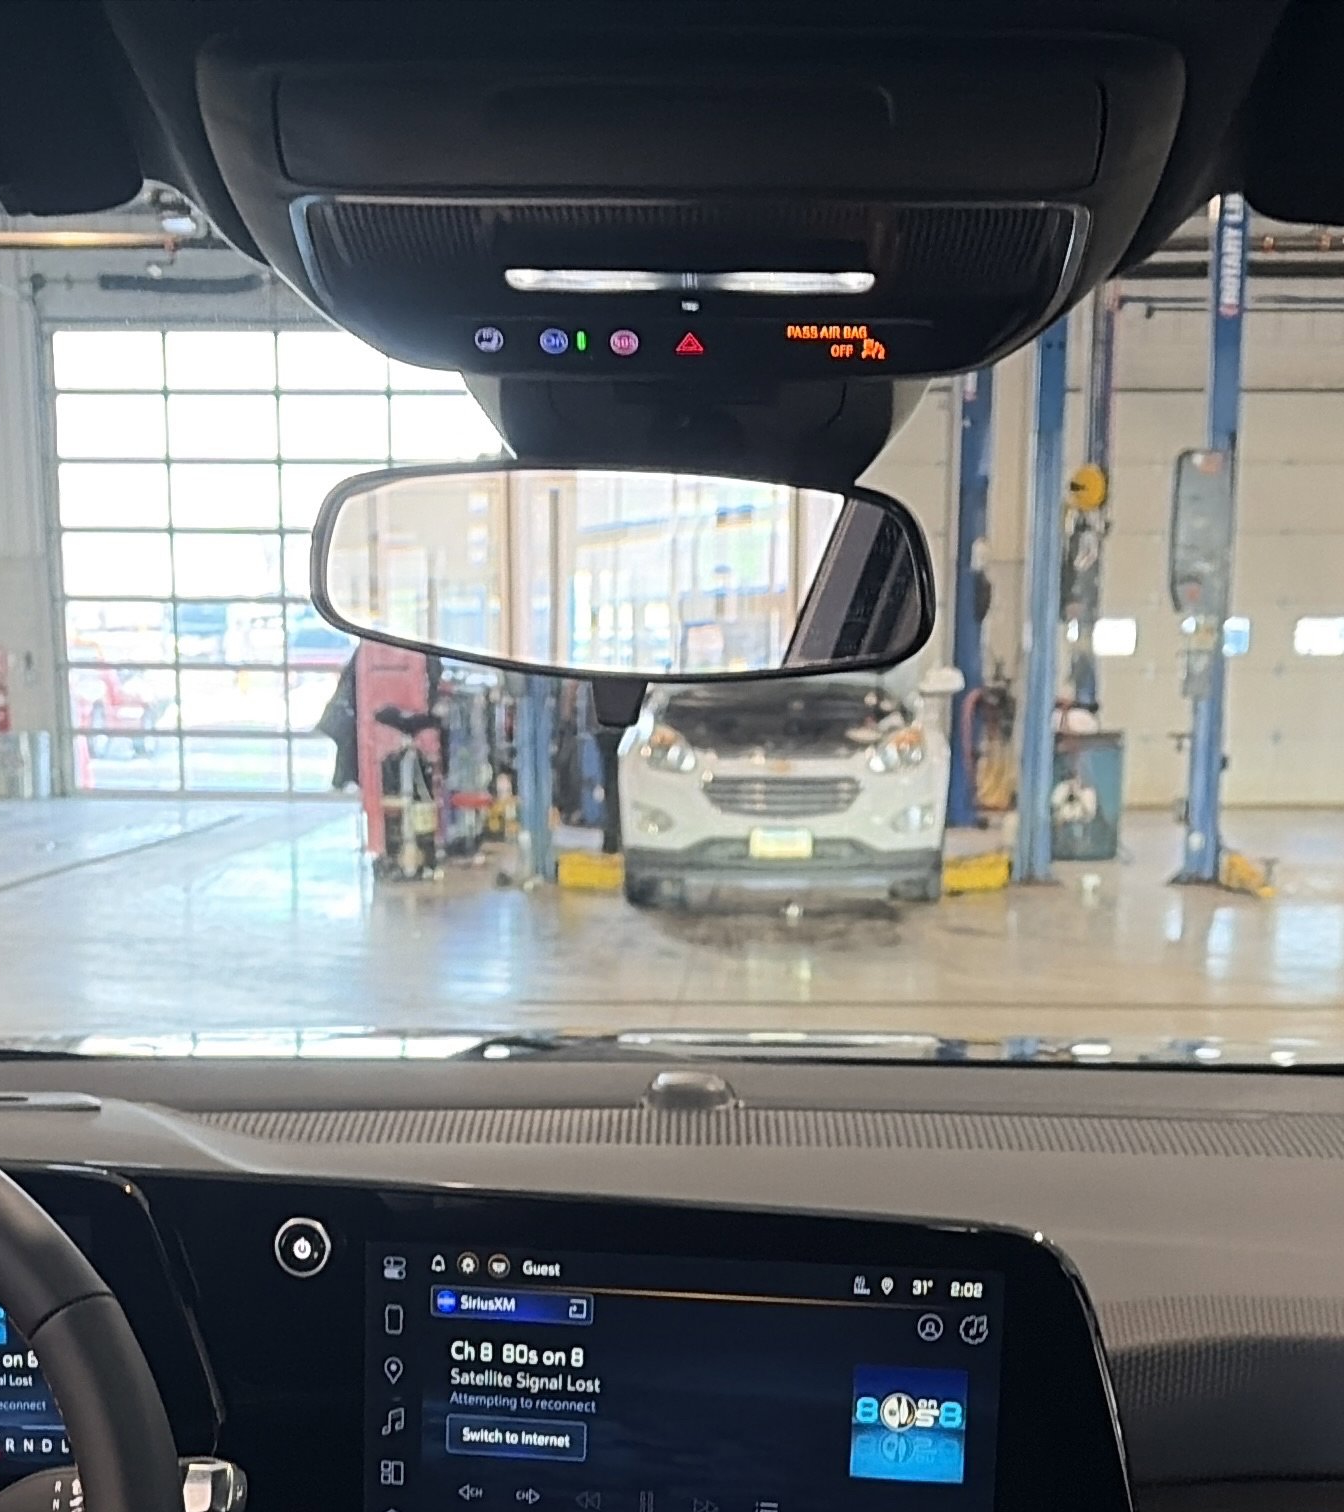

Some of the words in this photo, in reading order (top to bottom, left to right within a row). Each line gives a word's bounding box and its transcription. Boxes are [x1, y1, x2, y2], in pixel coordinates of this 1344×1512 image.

[787, 325, 818, 339] PASS
[820, 325, 841, 339] AIR
[843, 325, 867, 339] BAG
[830, 343, 854, 358] OFF
[522, 1259, 561, 1278] Guest
[912, 1278, 935, 1296] 31°
[950, 1280, 984, 1299] 2:02
[460, 1294, 517, 1313] SiriusXM
[2, 1353, 24, 1369] on
[450, 1340, 476, 1362] Ch
[479, 1341, 494, 1363] 8
[502, 1343, 539, 1365] 80s
[542, 1350, 567, 1367] on
[570, 1346, 585, 1368] 8
[9, 1374, 33, 1388] Lost
[450, 1367, 513, 1389] Satellite
[516, 1371, 563, 1394] Signal
[567, 1374, 602, 1394] Lost
[449, 1390, 518, 1412] Attempting
[520, 1396, 534, 1410] to
[535, 1398, 597, 1414] reconnect
[6, 1438, 16, 1453] R
[23, 1438, 35, 1453] N
[41, 1440, 53, 1453] D
[462, 1426, 503, 1444] Switch
[505, 1430, 519, 1445] to
[521, 1430, 571, 1449] Internet
[52, 1498, 60, 1511] N
